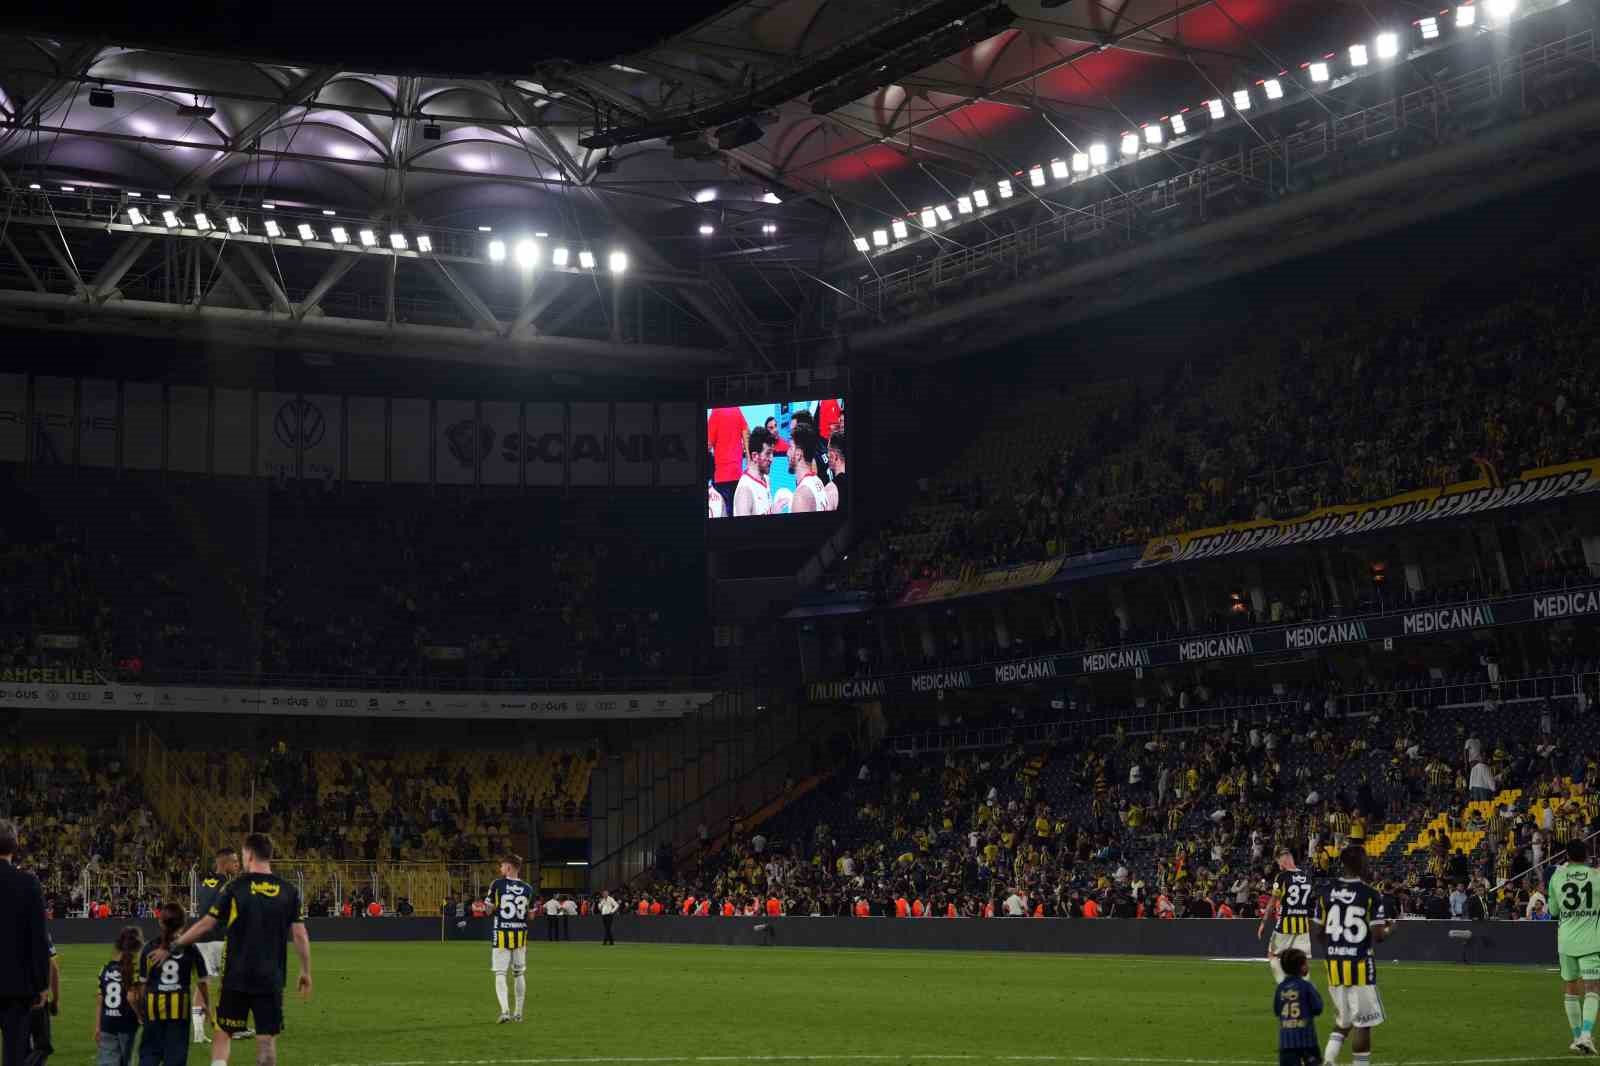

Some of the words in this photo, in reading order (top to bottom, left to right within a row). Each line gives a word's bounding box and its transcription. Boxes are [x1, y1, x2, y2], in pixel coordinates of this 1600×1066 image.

[502, 432, 689, 463] SCANIA
[1403, 607, 1485, 634] MEDICANA
[1286, 624, 1358, 648] MEDICANA
[1083, 651, 1142, 673] MEDICANA
[1179, 638, 1246, 661] MEDICANA
[911, 671, 968, 692] MEDICANA
[995, 661, 1050, 682] MEDICANA
[499, 894, 528, 919] 53
[1286, 884, 1312, 906] 37
[1561, 881, 1593, 910] 31
[1325, 904, 1368, 943] 45
[160, 959, 180, 985] 8
[104, 982, 122, 1009] 8
